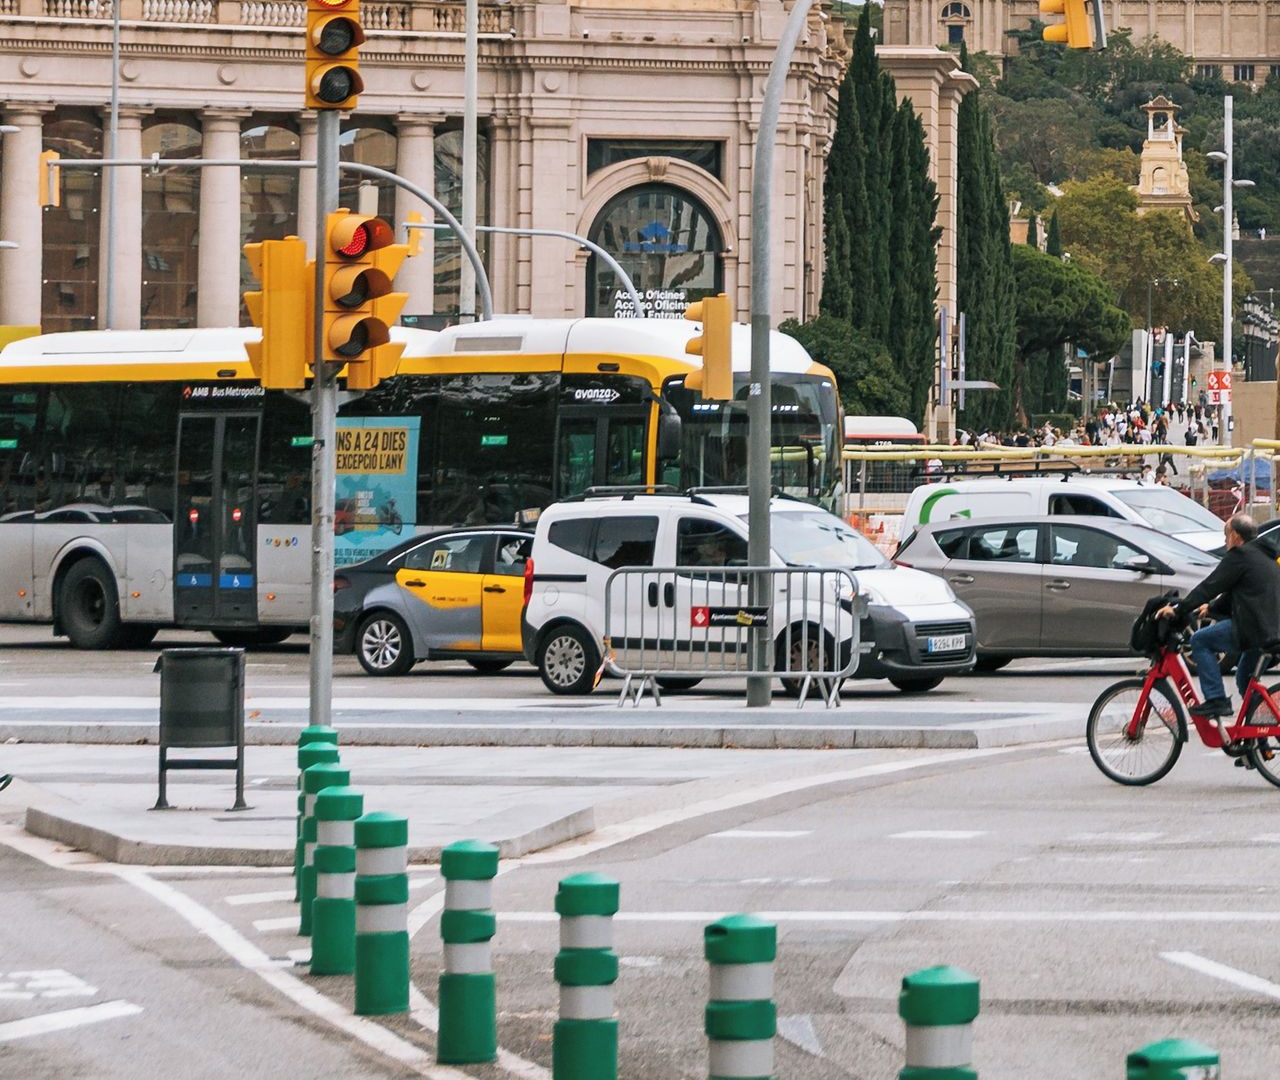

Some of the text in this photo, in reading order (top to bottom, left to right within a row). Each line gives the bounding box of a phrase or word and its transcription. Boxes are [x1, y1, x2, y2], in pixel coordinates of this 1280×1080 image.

[614, 300, 653, 310] Accso
[192, 387, 209, 397] AMB
[212, 387, 225, 397] Bus
[575, 388, 612, 399] avanza
[354, 431, 362, 452] A
[364, 431, 380, 454] 24
[381, 431, 406, 452] DIES
[379, 453, 404, 470] L'ANY
